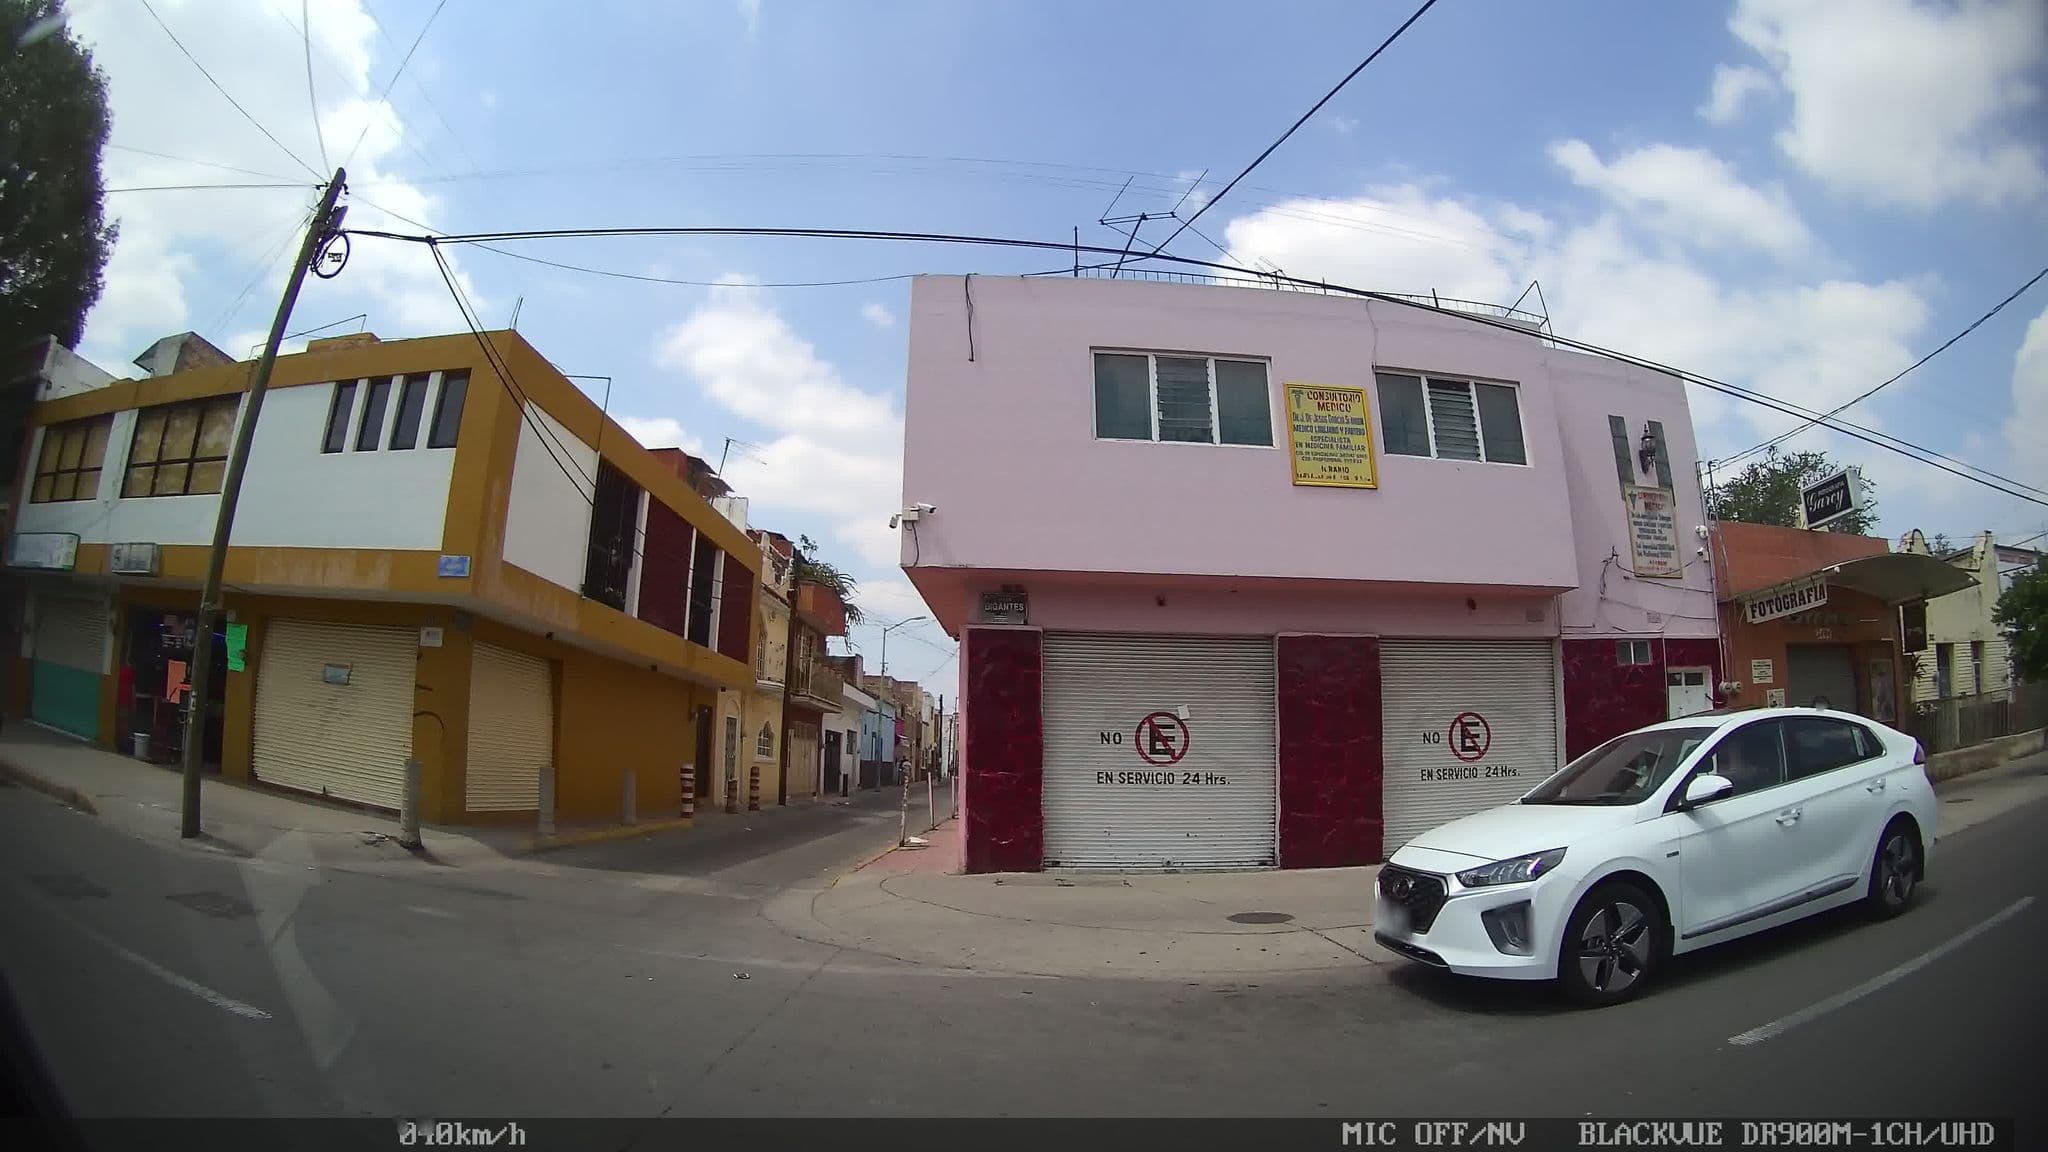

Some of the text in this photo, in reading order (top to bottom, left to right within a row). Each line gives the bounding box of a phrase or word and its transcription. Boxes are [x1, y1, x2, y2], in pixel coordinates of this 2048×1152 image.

[1307, 391, 1361, 403] CONSULTORIO
[1317, 402, 1352, 413] MEDICO
[1310, 435, 1352, 443] ESPECIALISTA
[1336, 443, 1366, 452] FAMILIAR
[1750, 583, 1826, 619] FOTOGRAFIA
[1100, 732, 1122, 745] NO
[1422, 732, 1440, 744] NO
[1097, 772, 1231, 785] EN SERVICIO 24 Hrs.
[1420, 765, 1520, 781] EN SERVICIO 24 Hrs.
